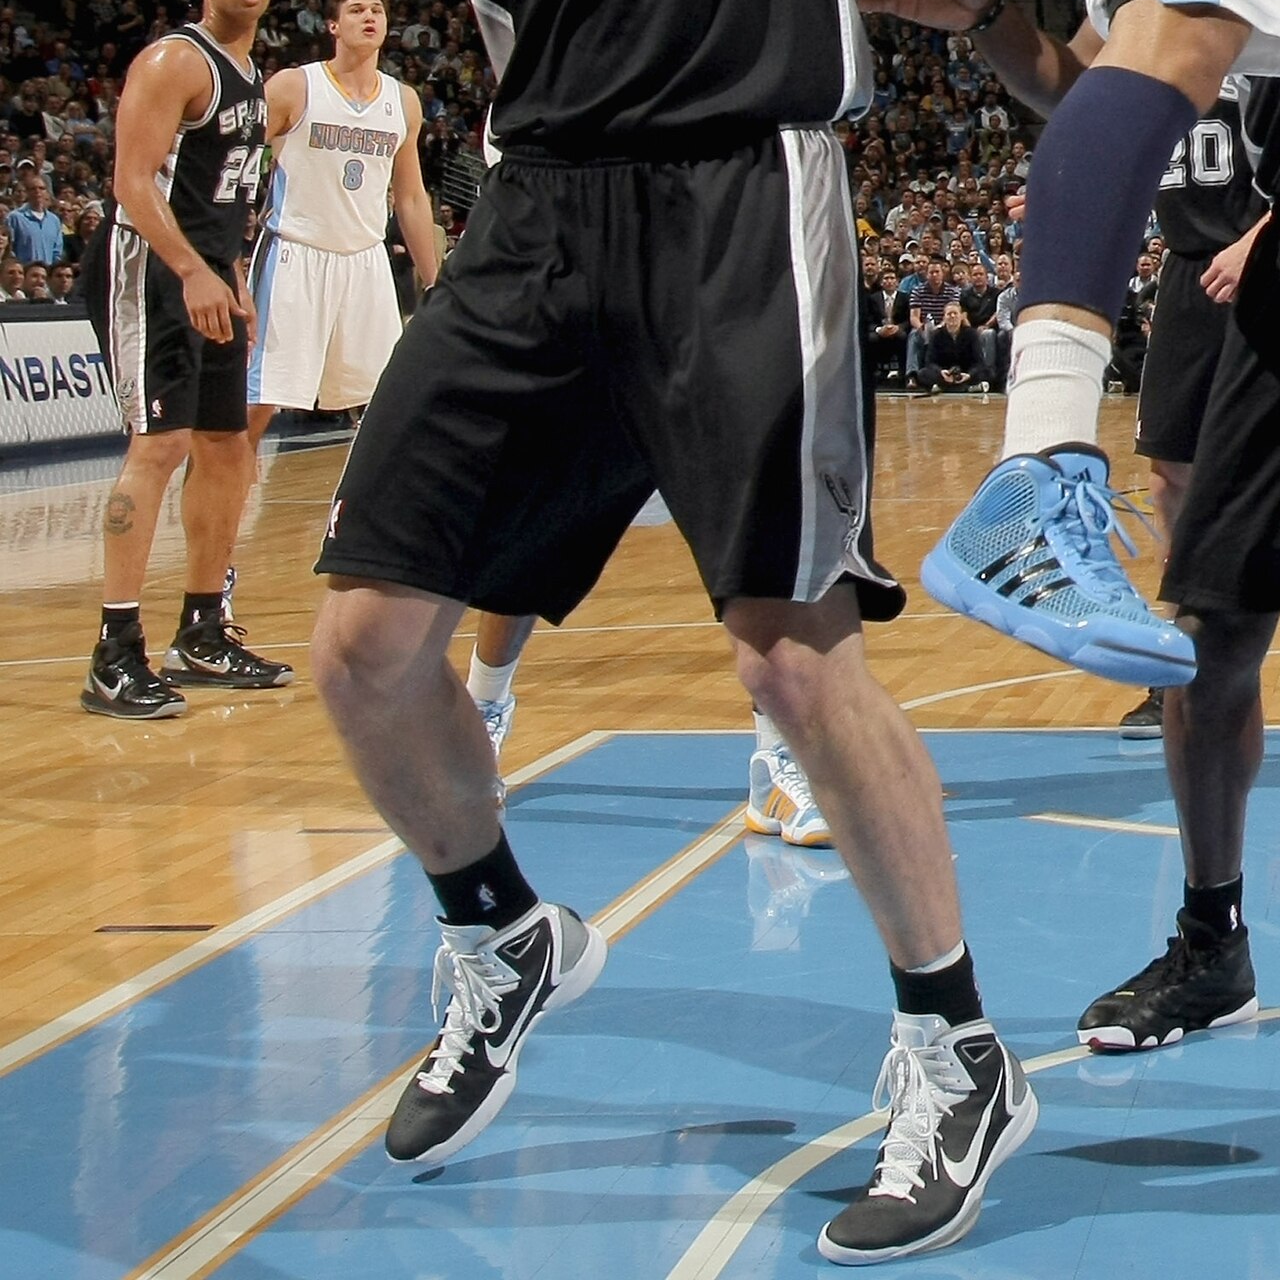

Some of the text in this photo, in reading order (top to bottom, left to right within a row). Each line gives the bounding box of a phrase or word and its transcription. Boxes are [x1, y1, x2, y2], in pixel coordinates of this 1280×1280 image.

[218, 97, 268, 136] SPUR
[309, 122, 400, 158] NUGGETS
[213, 143, 266, 204] 24
[342, 159, 365, 191] 8
[0, 353, 107, 402] NBAST
